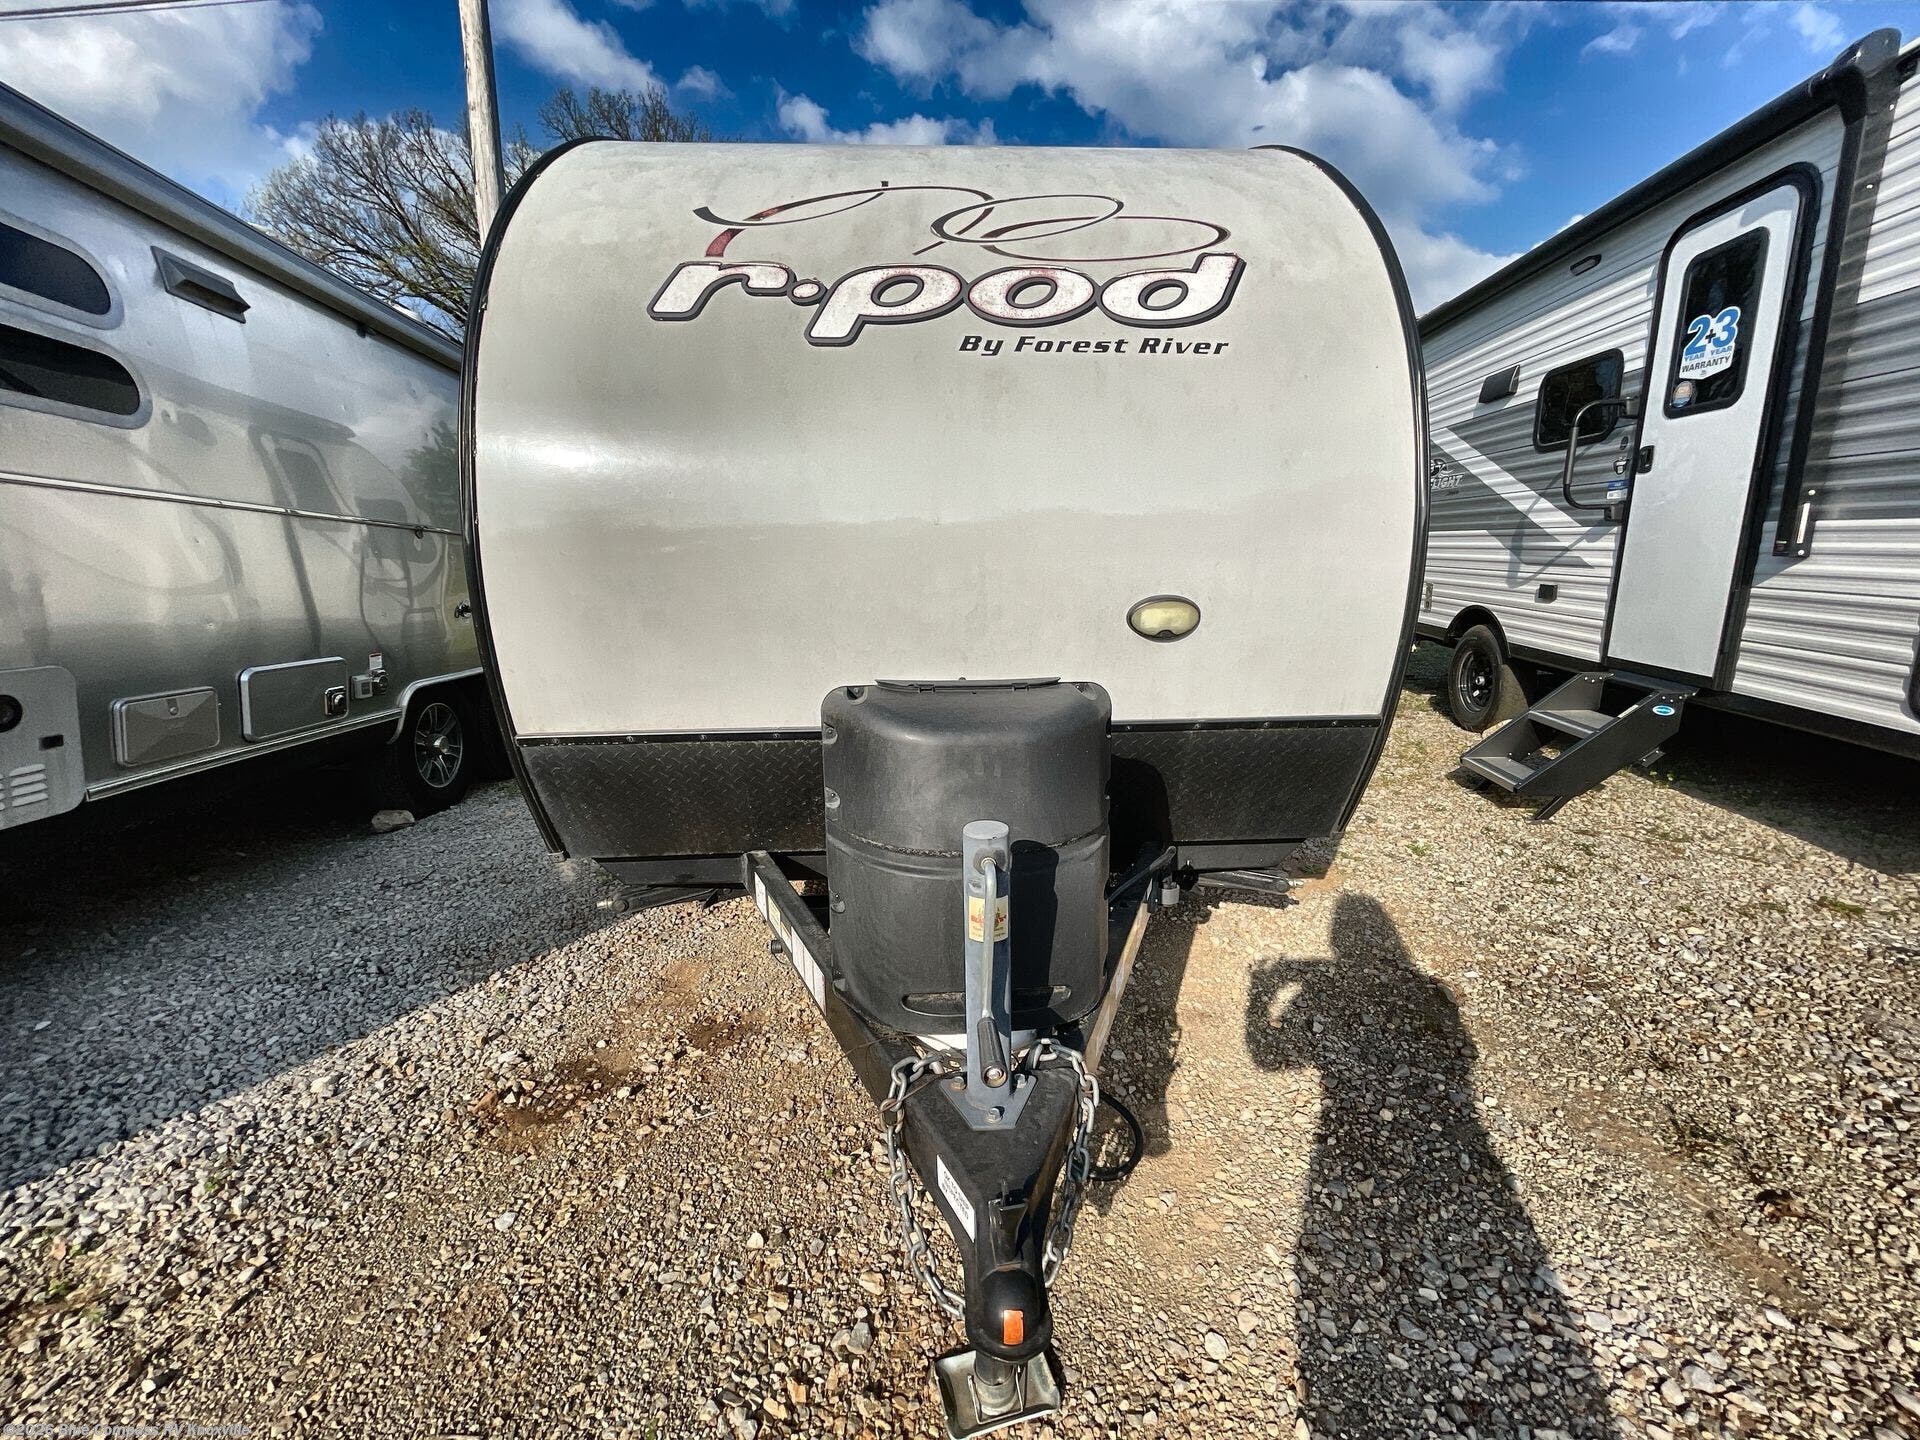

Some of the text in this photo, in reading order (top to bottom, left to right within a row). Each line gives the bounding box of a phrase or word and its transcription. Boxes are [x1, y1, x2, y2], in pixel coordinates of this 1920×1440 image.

[958, 335, 1229, 356] By Forest River
[1684, 346, 1733, 362] YEAR YEAR
[1682, 356, 1731, 373] WARRANTY
